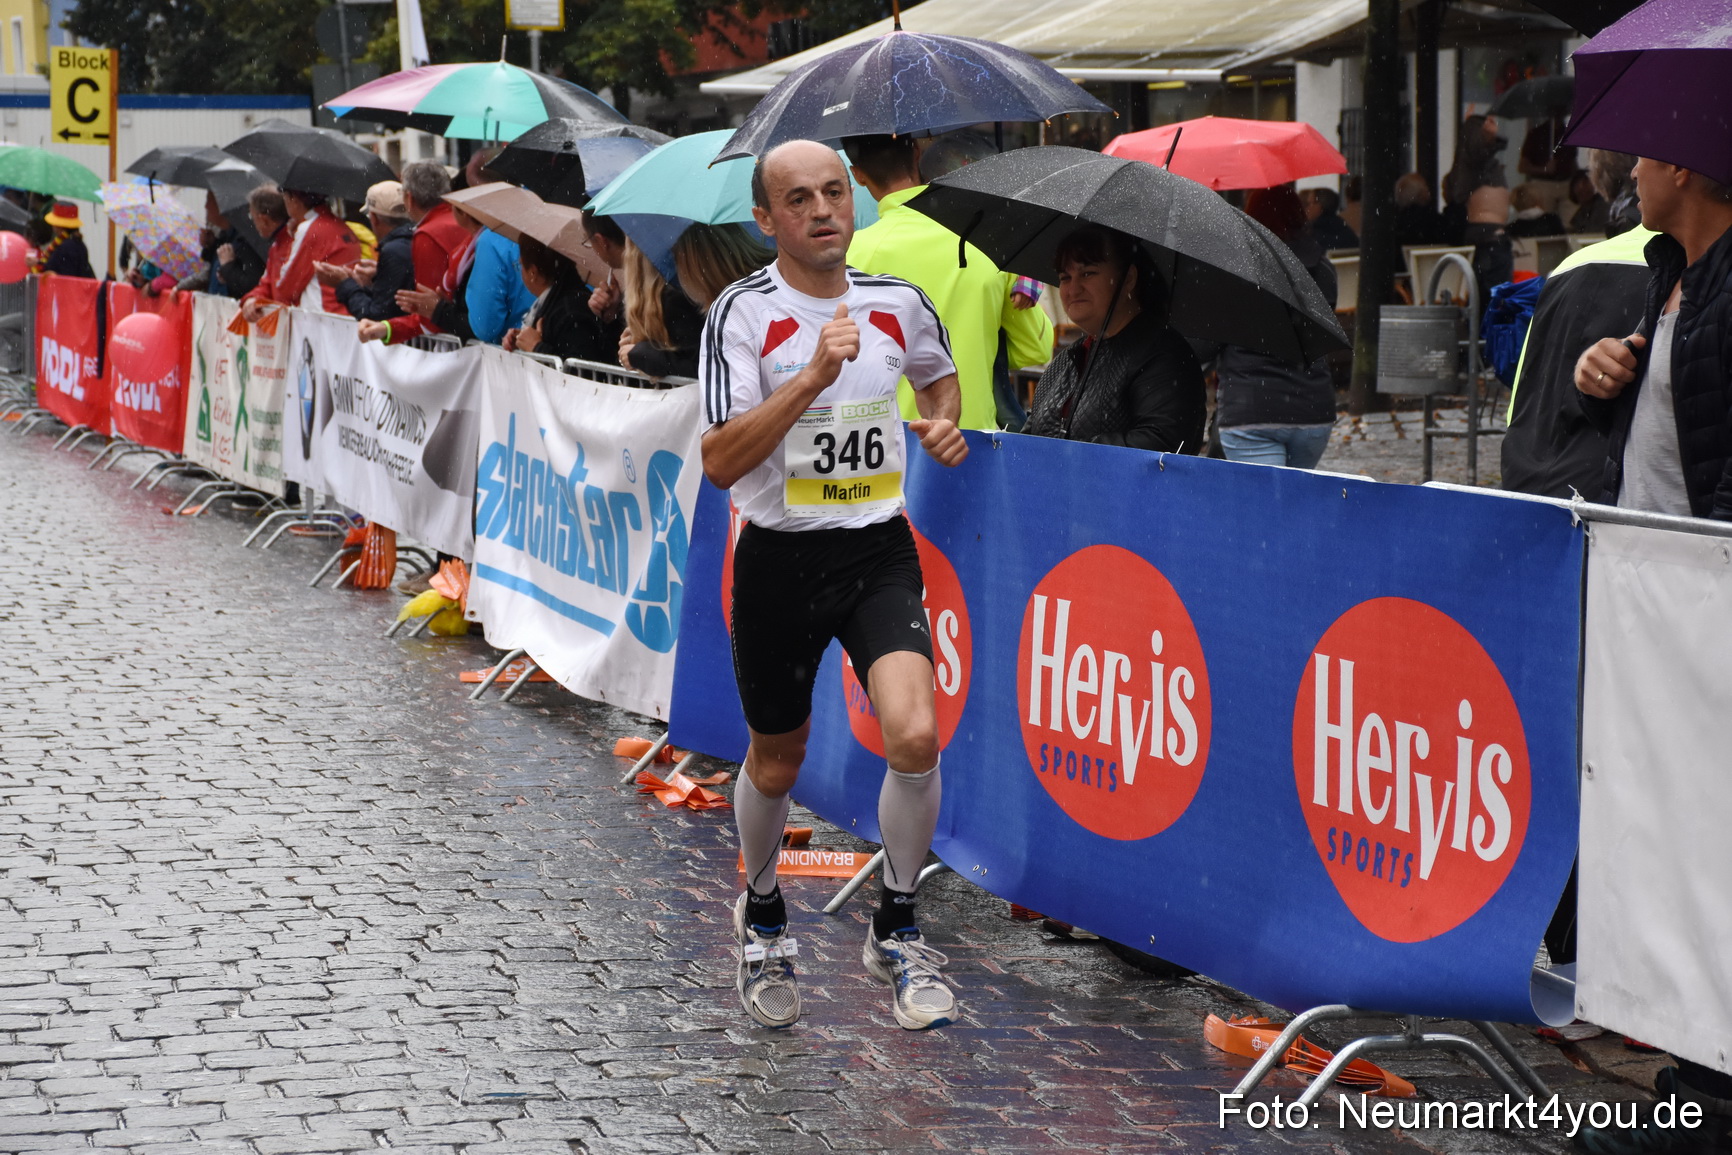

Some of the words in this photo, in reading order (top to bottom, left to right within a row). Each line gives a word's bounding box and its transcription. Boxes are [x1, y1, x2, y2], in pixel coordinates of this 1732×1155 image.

[58, 50, 110, 71] Block
[67, 76, 100, 124] C
[841, 400, 889, 419] BOCK
[813, 427, 885, 475] 346
[822, 483, 871, 501] Martin
[1028, 593, 1199, 785] Hervis
[1040, 743, 1118, 793] SPORTS
[1313, 652, 1513, 881] Hervis
[1327, 826, 1414, 889] SPORTS
